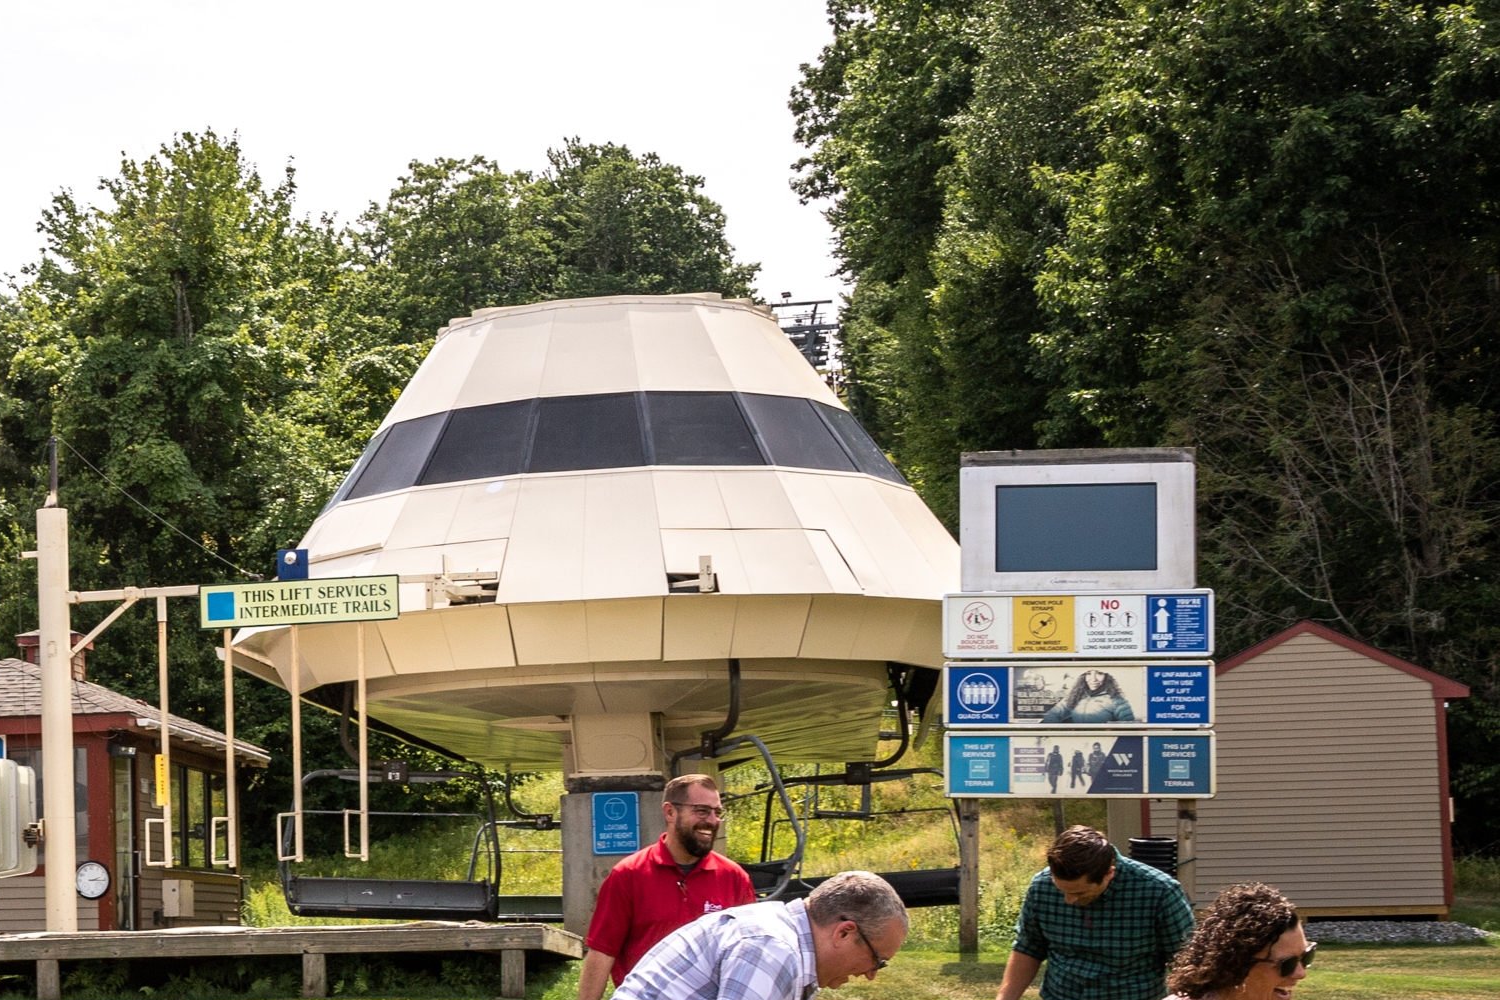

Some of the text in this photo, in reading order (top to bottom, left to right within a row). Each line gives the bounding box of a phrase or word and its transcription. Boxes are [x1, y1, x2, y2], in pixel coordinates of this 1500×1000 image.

[242, 583, 387, 603] THIS LIFT SERVICES
[240, 599, 391, 619] INTERMEDIATE TRAILS
[1101, 600, 1120, 610] NO
